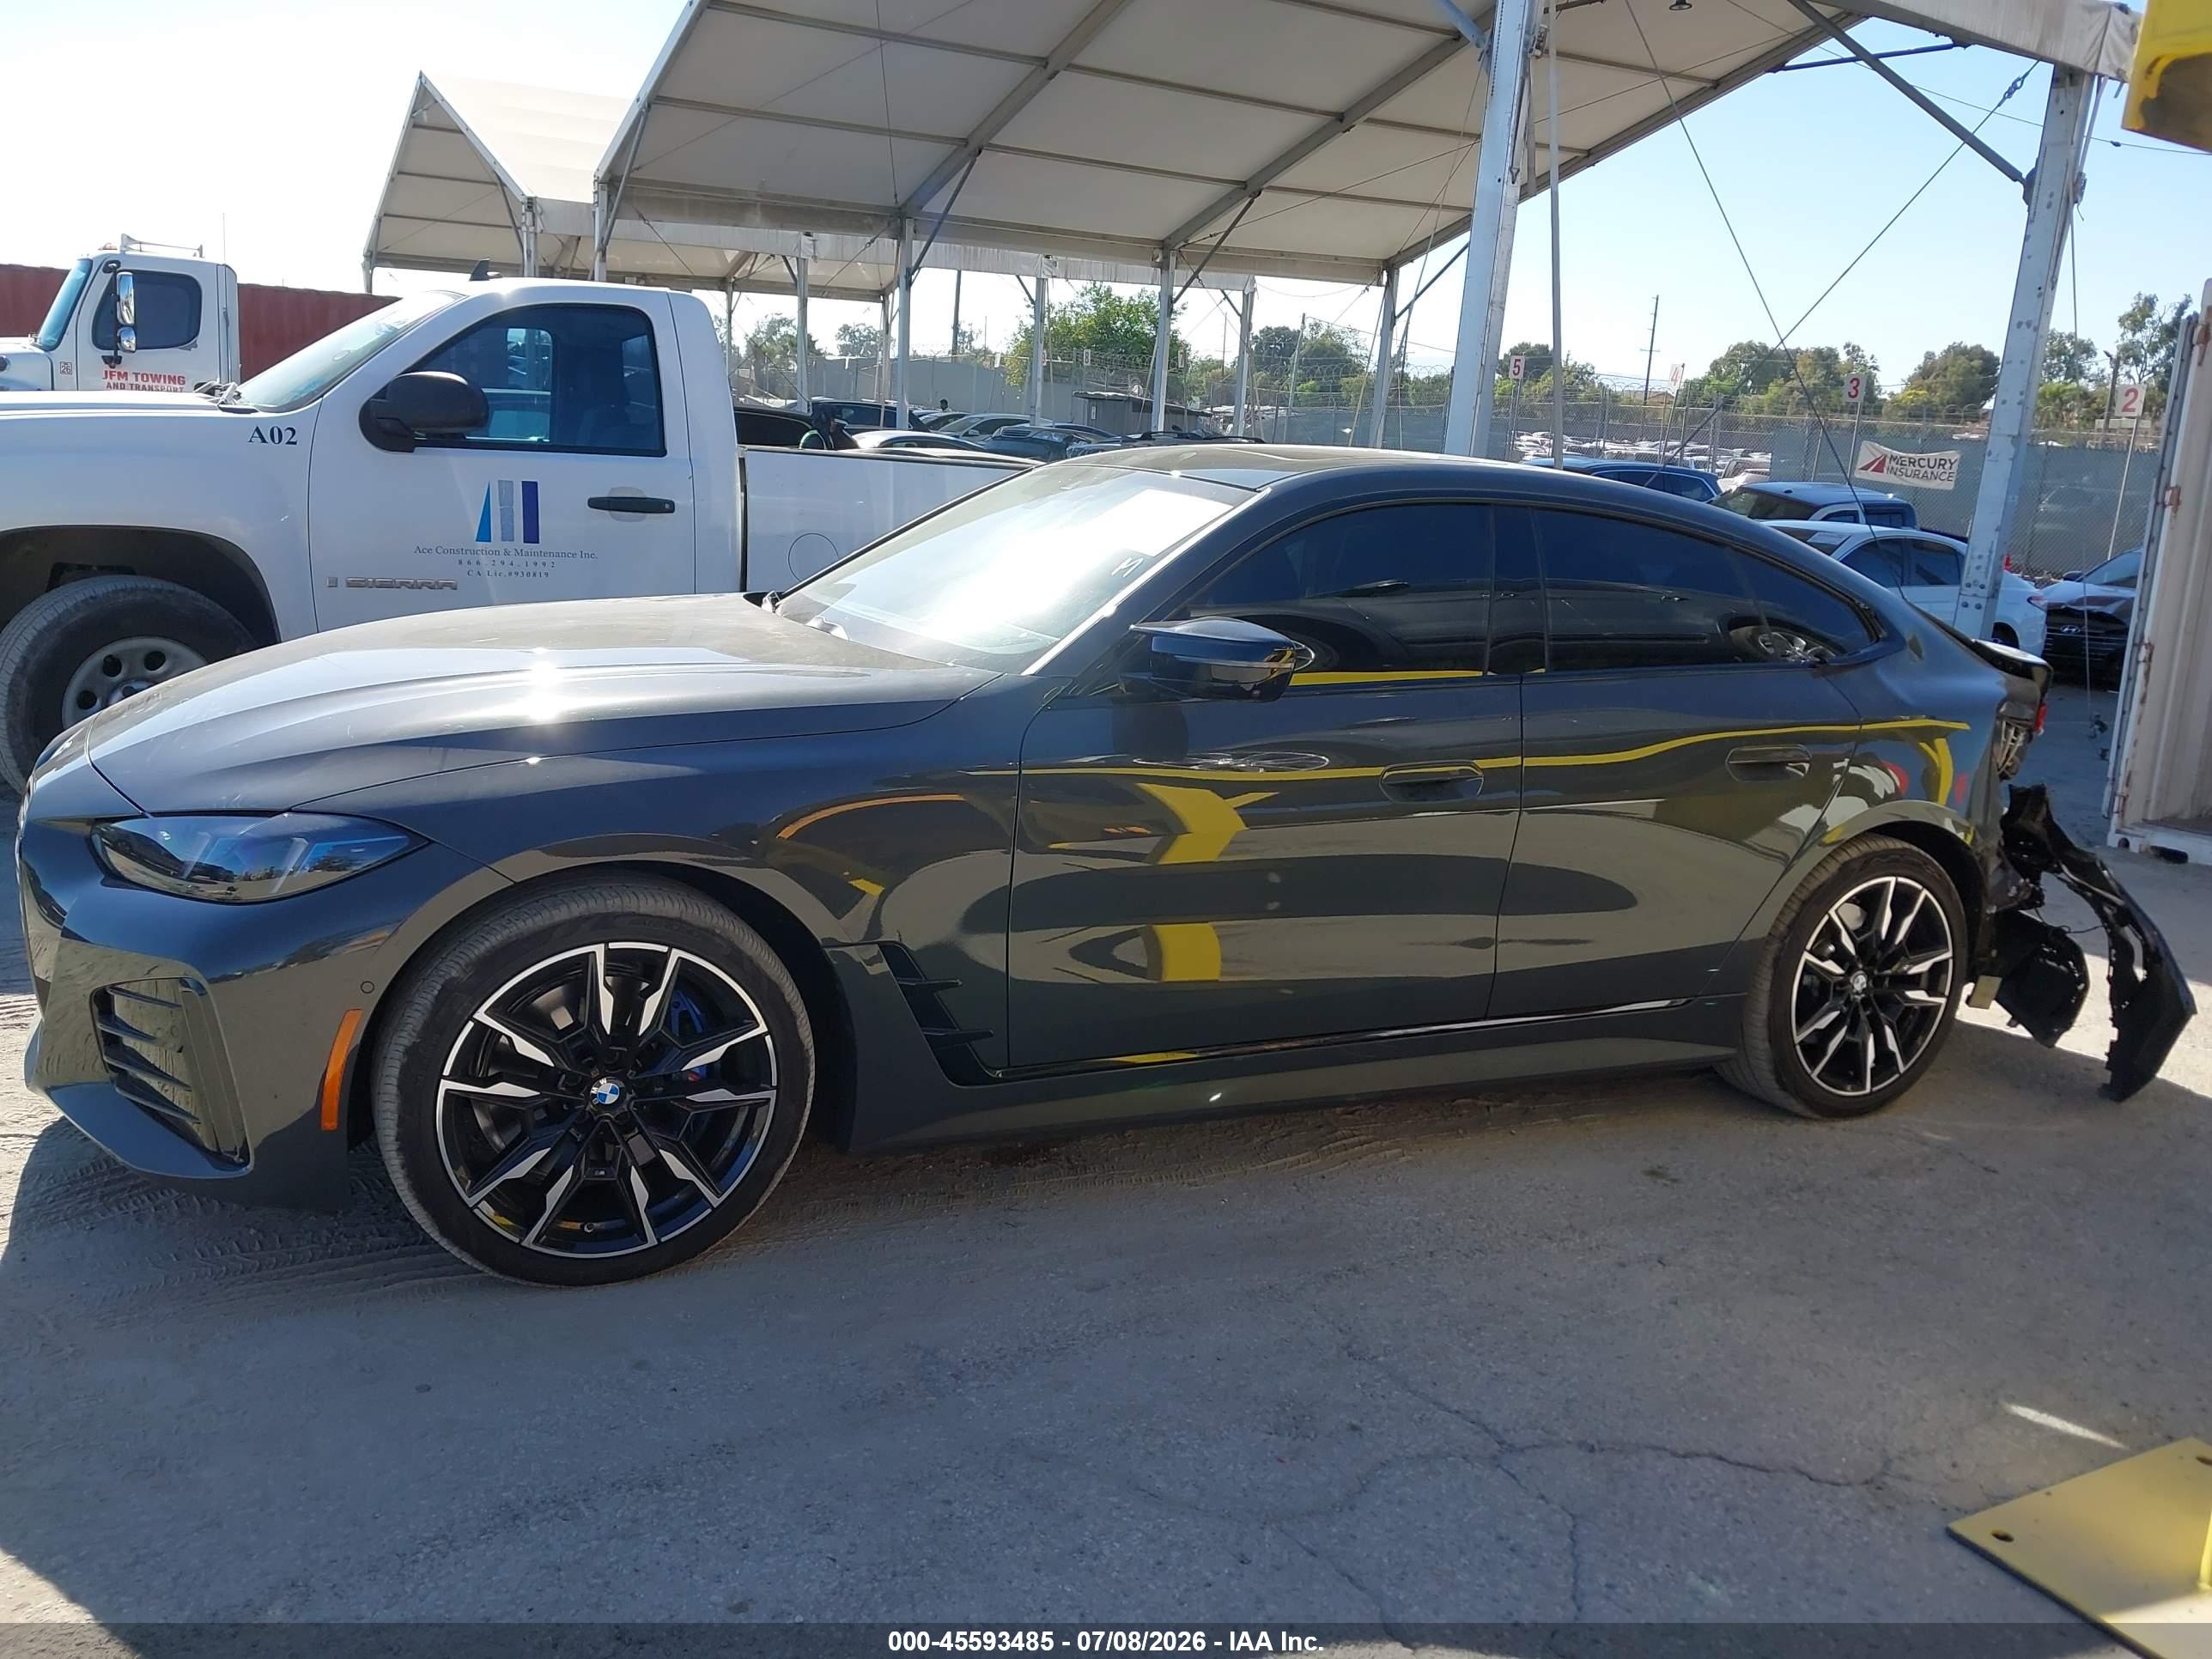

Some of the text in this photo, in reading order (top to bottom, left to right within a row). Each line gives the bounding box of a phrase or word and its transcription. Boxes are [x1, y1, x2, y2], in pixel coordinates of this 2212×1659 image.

[1512, 358, 1521, 376] 5
[102, 370, 185, 386] JFM TOWING
[1670, 367, 1679, 386] 4
[129, 383, 185, 392] TRANSPORT
[1848, 377, 1861, 398] 3
[2122, 387, 2139, 412] 2
[247, 425, 298, 446] A02
[1889, 453, 1958, 471] MERCURY
[1887, 467, 1955, 482] INSURANCE
[414, 545, 599, 559] Ace Construction & Maintenance Inc.
[345, 576, 458, 591] SIERRA
